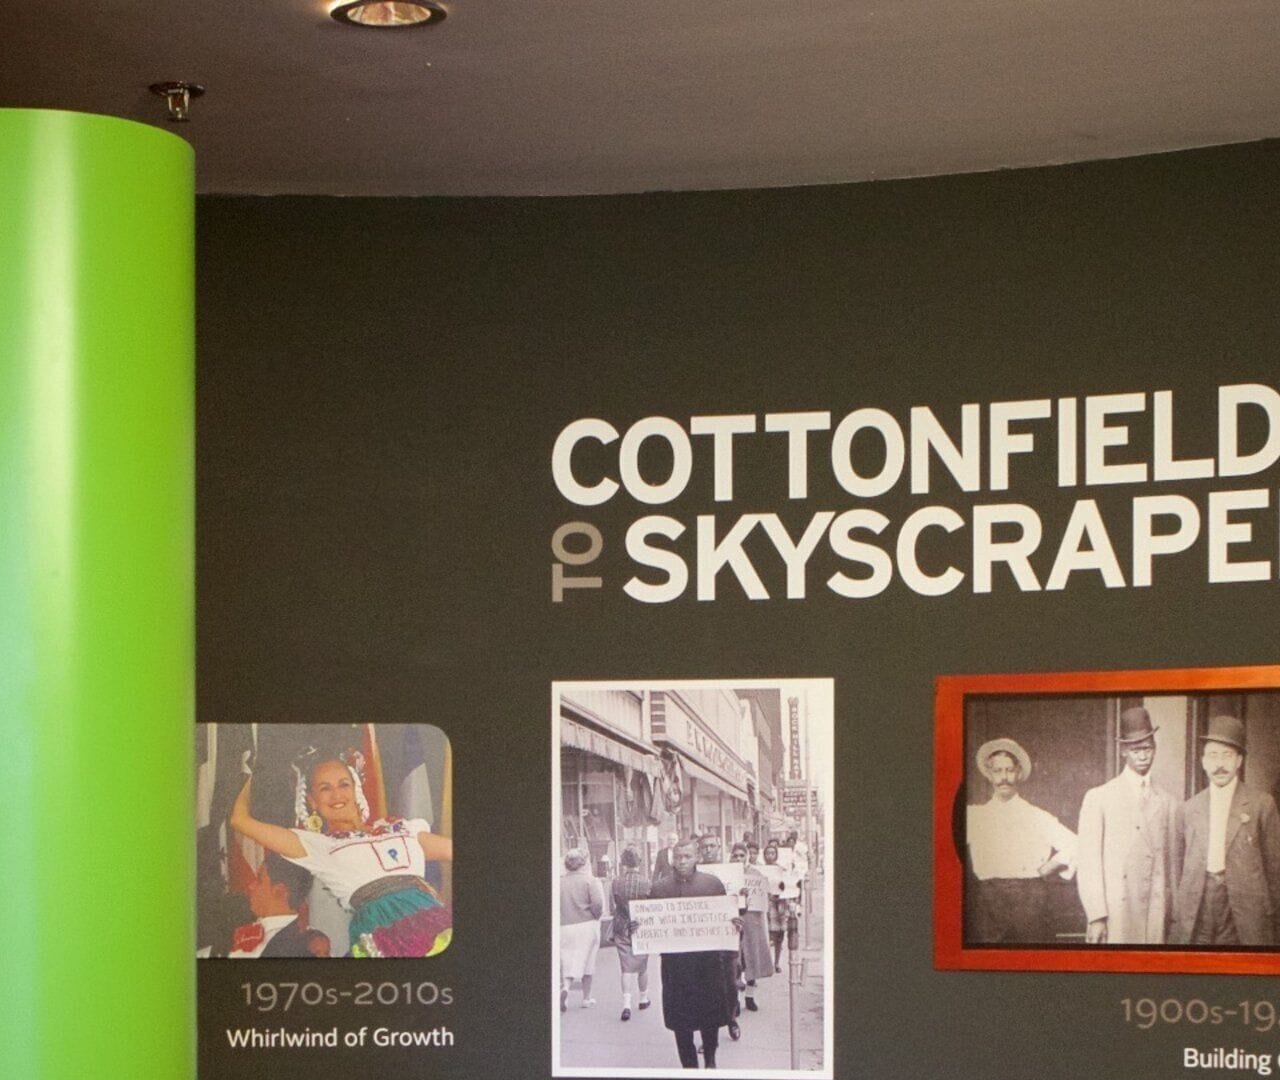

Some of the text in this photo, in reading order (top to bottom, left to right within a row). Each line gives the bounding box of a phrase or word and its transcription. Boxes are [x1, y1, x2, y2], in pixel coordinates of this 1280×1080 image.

[552, 522, 603, 602] TO
[242, 982, 453, 1011] 1970s-2010s
[227, 1027, 454, 1047] Whirlwind of Growth
[1184, 1048, 1271, 1075] Building
